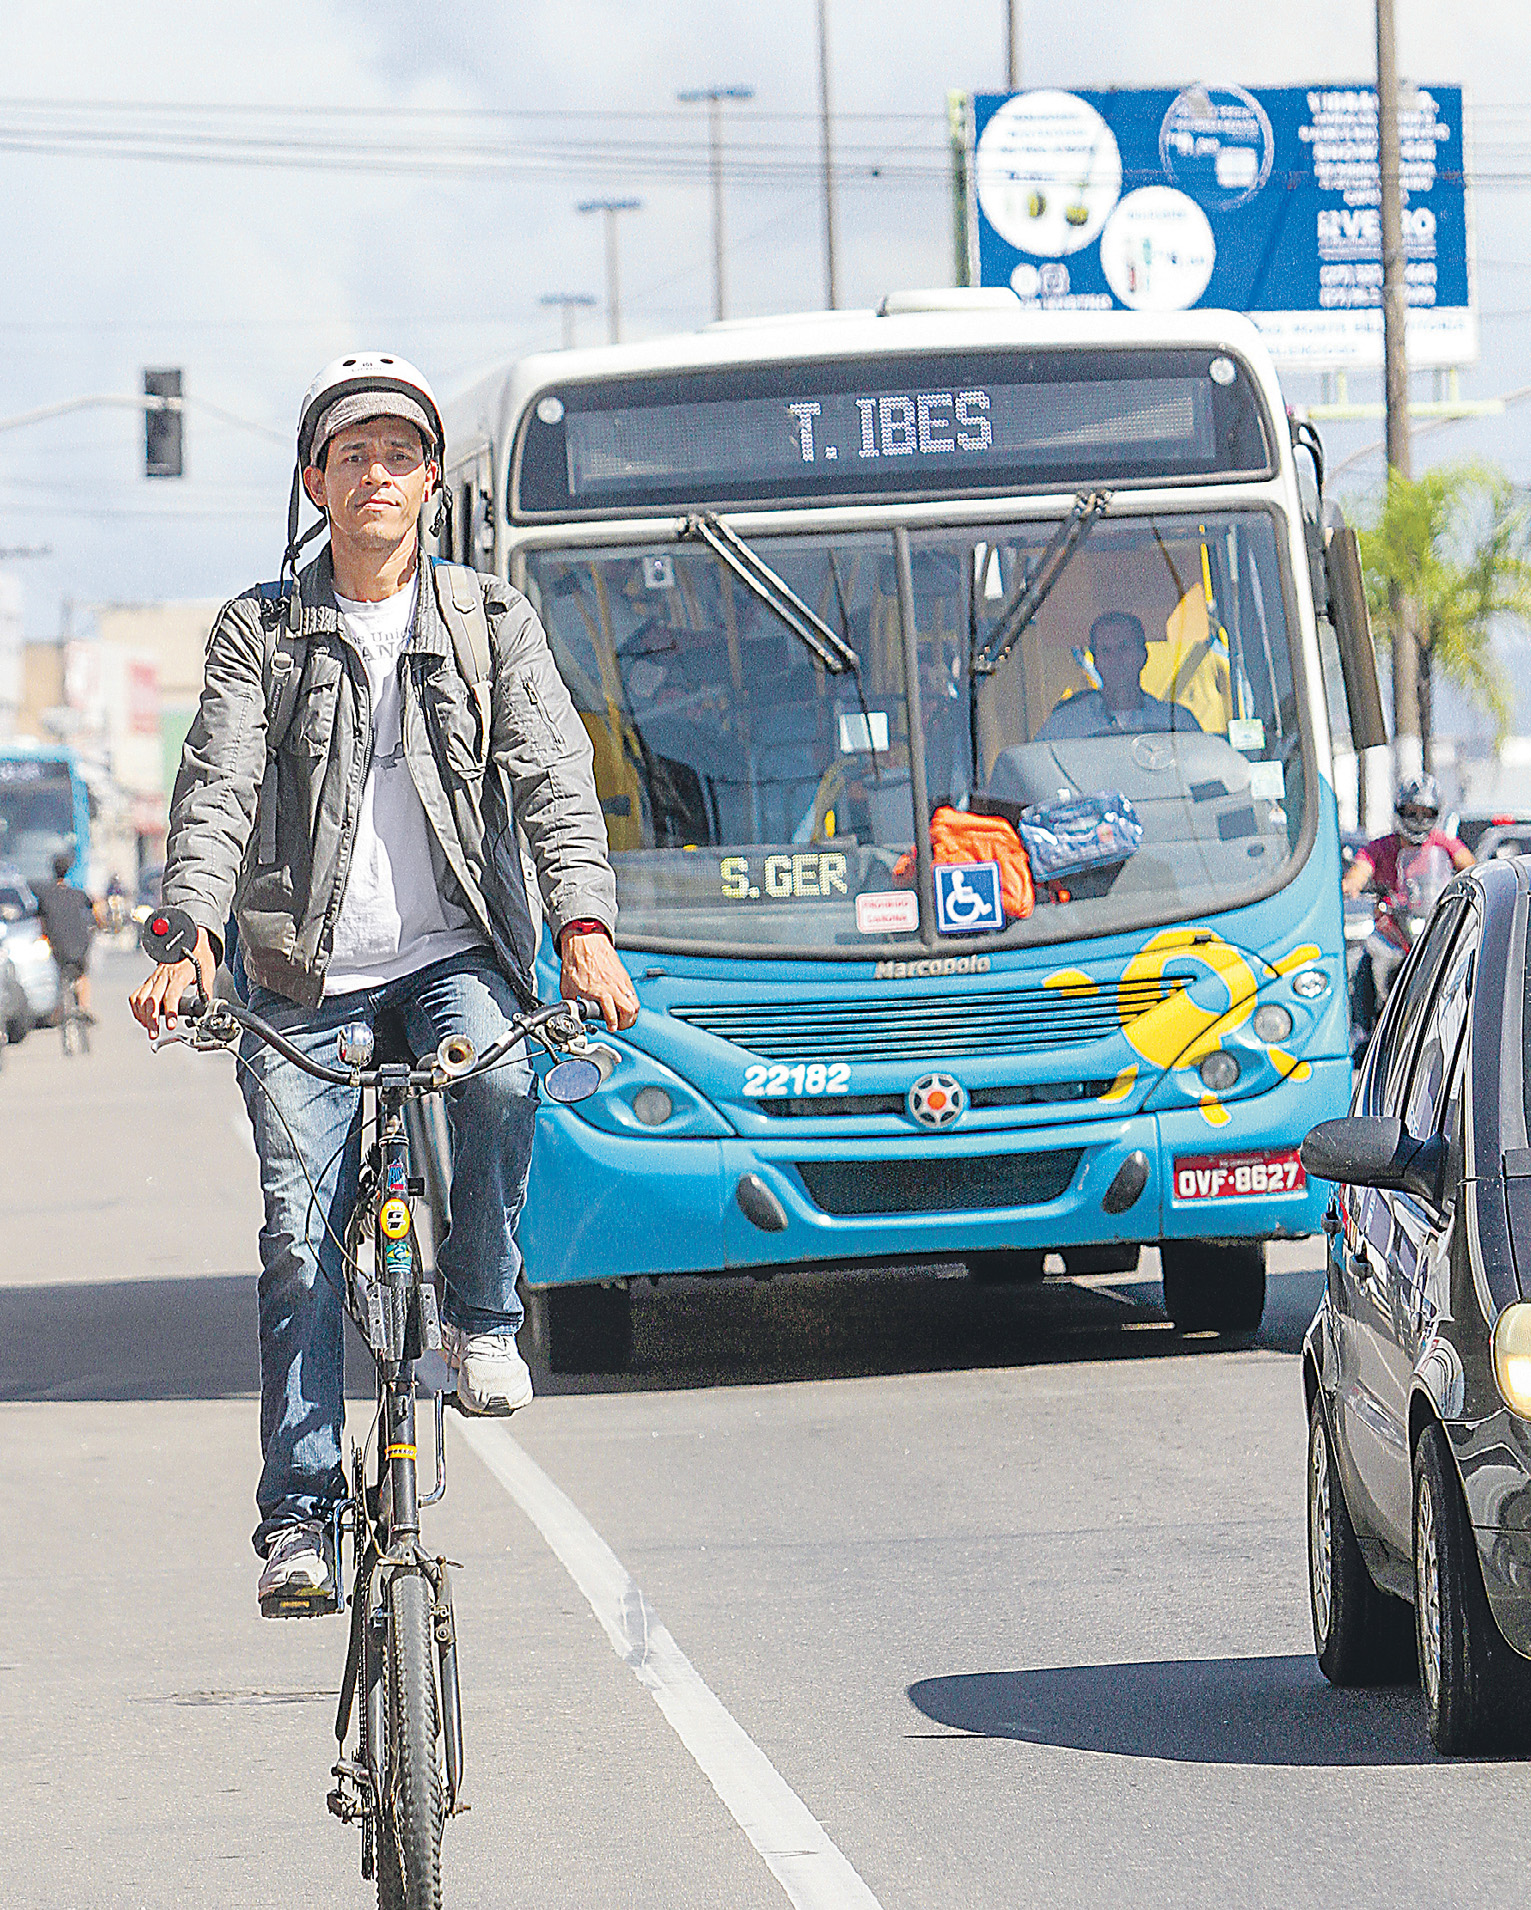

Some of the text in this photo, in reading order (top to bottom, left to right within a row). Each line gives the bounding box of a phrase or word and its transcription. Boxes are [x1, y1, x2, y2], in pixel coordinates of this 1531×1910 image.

[789, 390, 993, 461] T. IBES
[875, 954, 991, 980] Marcopolo
[742, 1063, 851, 1096] 22182
